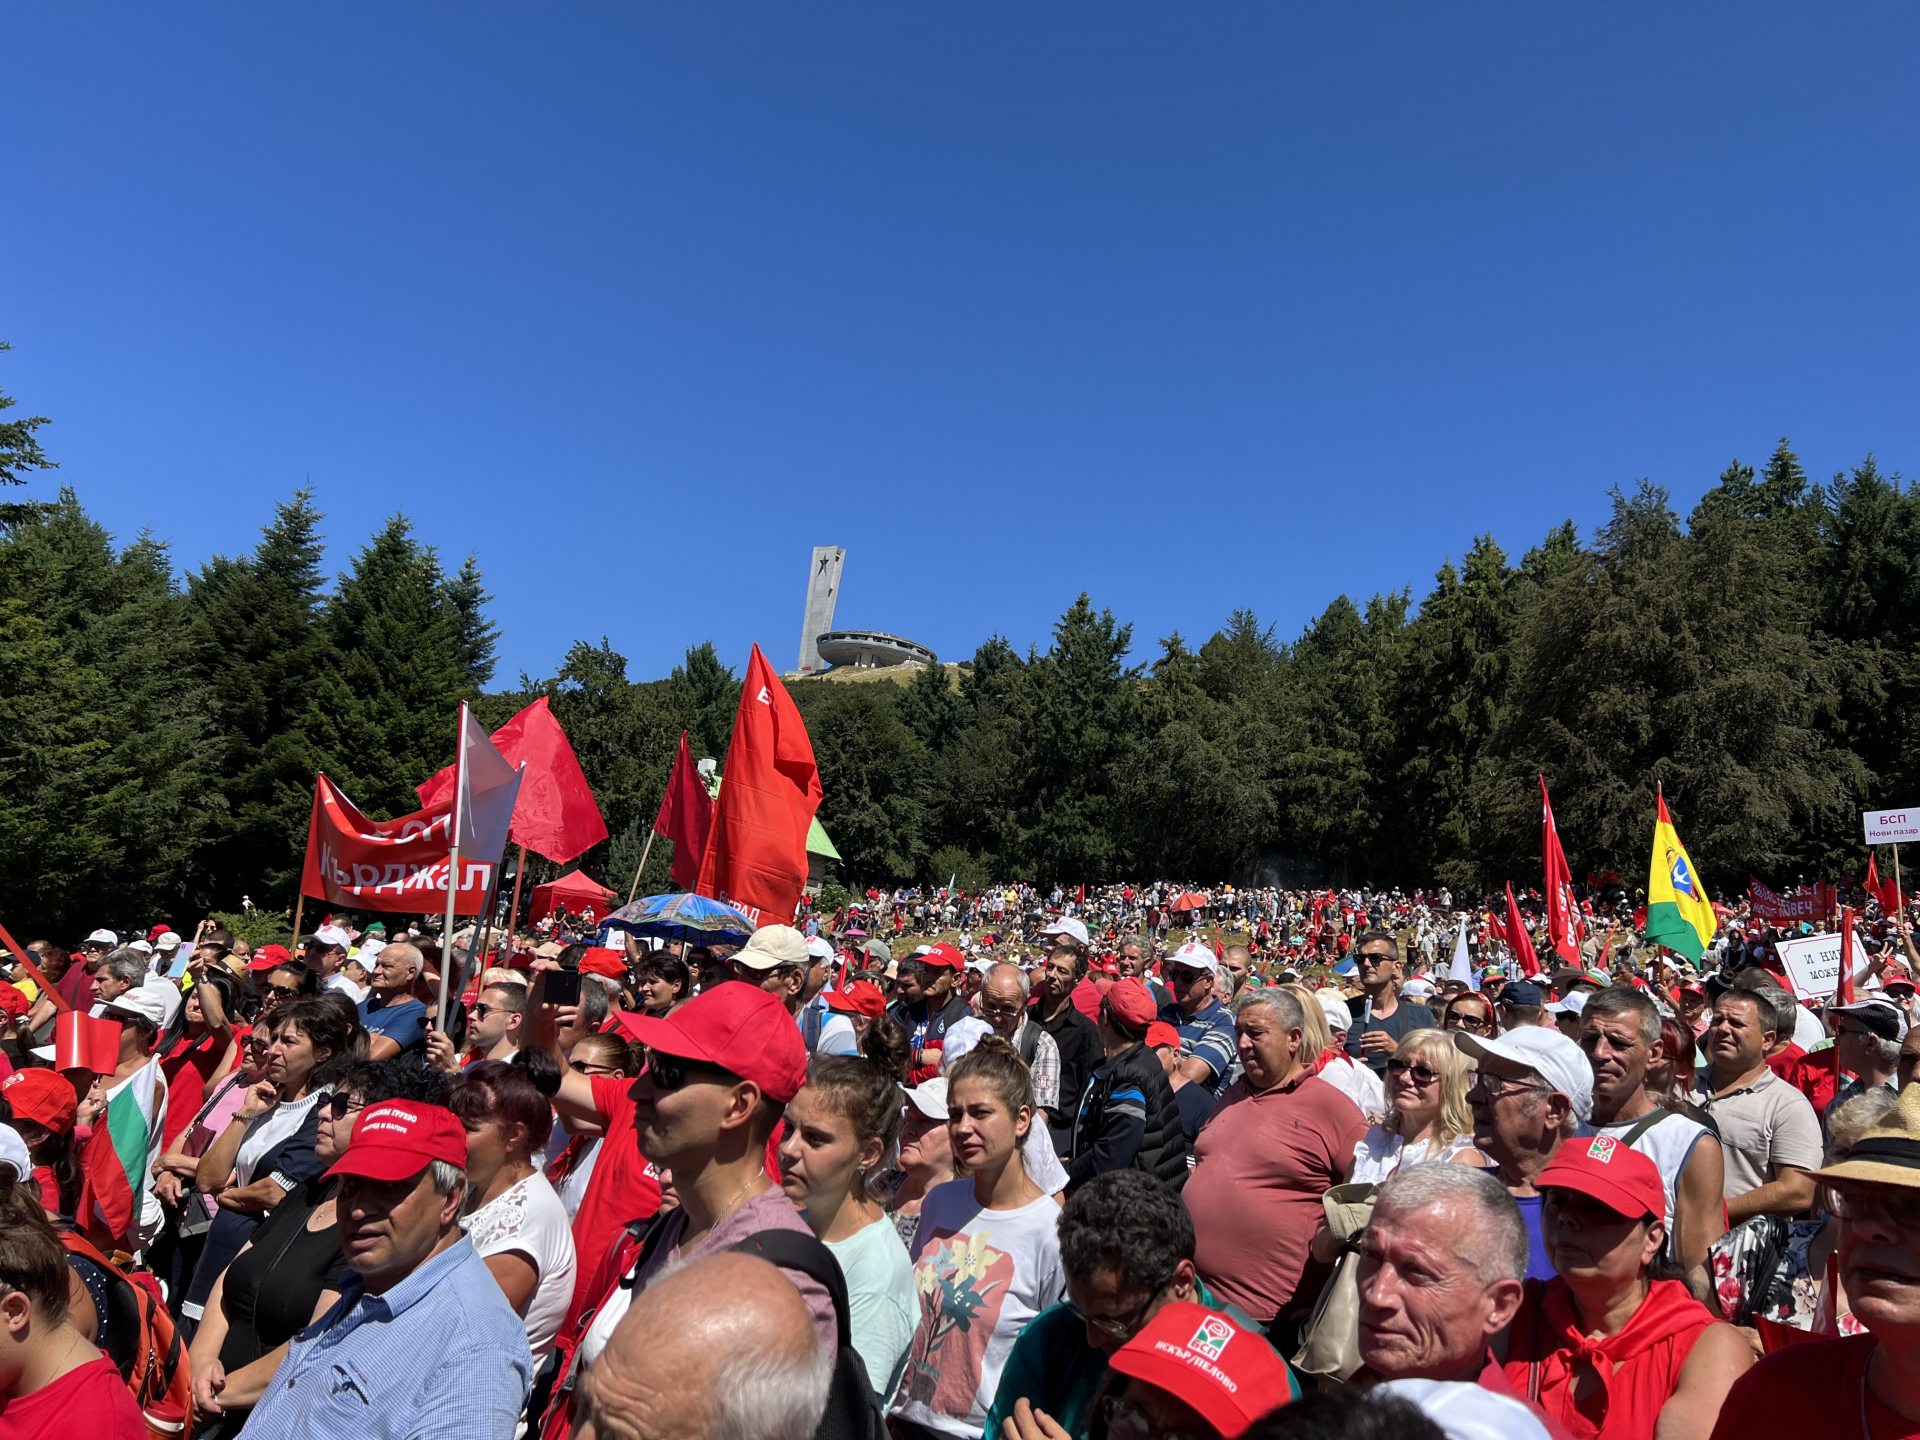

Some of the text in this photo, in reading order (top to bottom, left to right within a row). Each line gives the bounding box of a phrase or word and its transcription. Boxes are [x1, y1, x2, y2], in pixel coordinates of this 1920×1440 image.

[1879, 814, 1907, 825] БСП
[320, 842, 493, 895] Кърджал
[1803, 953, 1815, 965] И
[1809, 967, 1839, 980] МОЖЕ
[1589, 1150, 1609, 1162] БСП
[1190, 1339, 1219, 1358] БСП
